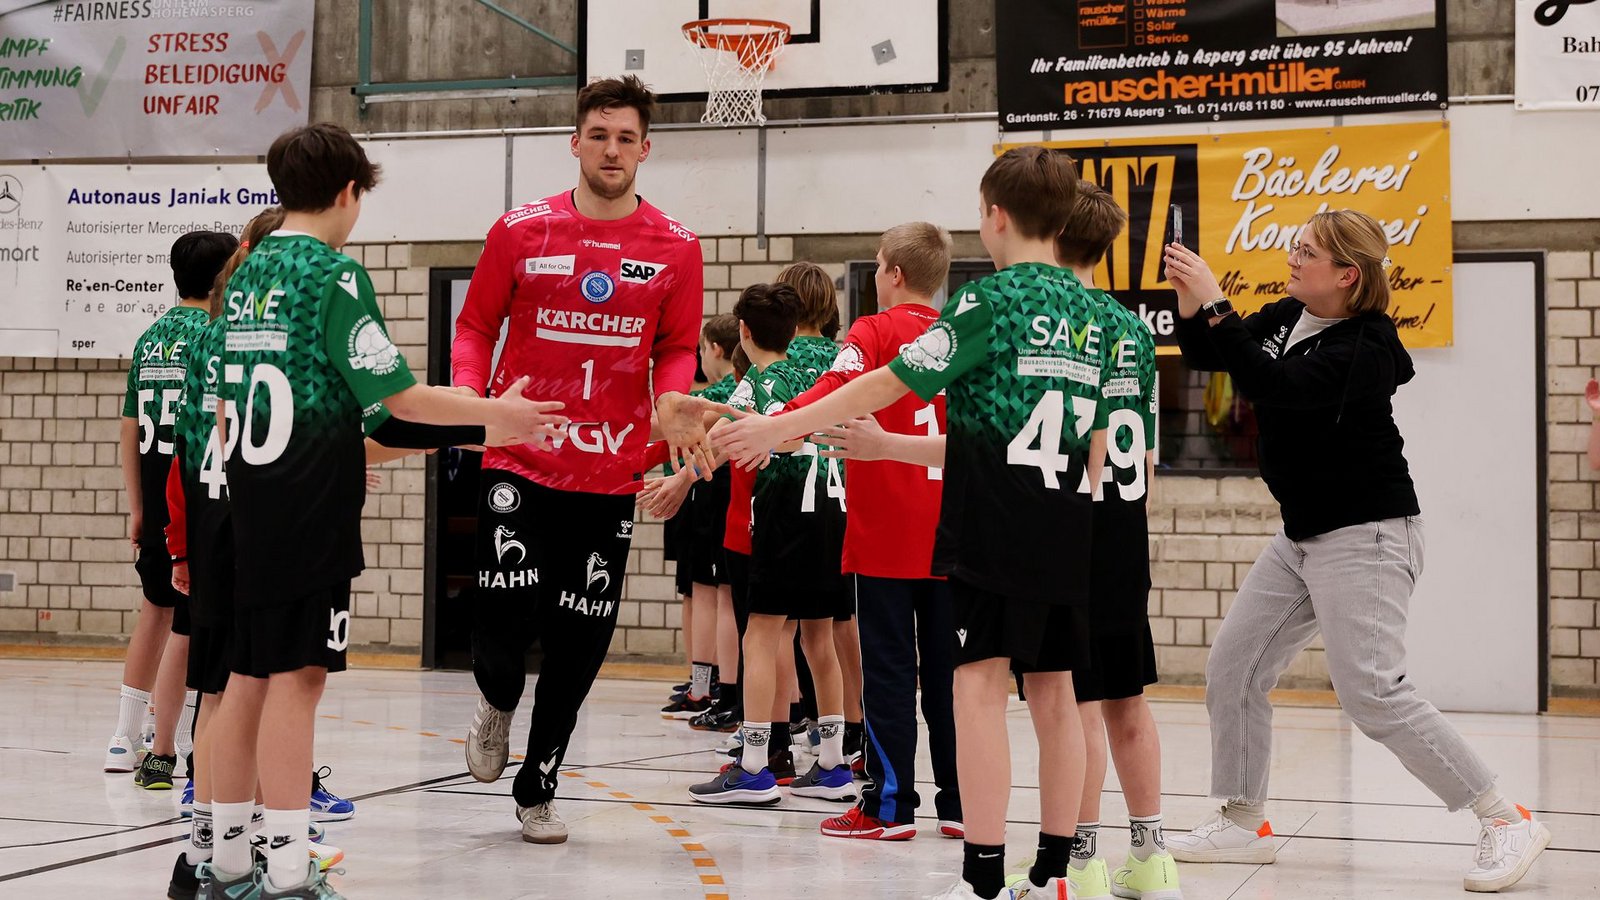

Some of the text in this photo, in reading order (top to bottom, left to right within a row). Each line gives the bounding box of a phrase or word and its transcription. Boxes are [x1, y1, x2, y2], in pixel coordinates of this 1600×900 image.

[53, 0, 151, 22] #FAIRNESS
[1080, 4, 1126, 15] rauscher
[1146, 8, 1186, 18] Wärme
[1146, 21, 1177, 31] Solar
[147, 32, 229, 53] STRESS
[1146, 33, 1189, 44] Service
[1030, 36, 1414, 74] Ihr Familienbetrieb in Asperg seit über 95 Jahren!
[144, 62, 288, 86] BELEIDIGUNG
[1064, 61, 1367, 105] rauscher+müller GMBH
[1576, 86, 1600, 103] 07
[143, 95, 220, 116] UNFAIR
[1006, 112, 1061, 124] Gartenstr.
[1063, 110, 1078, 121] 26
[1087, 107, 1121, 120] 71679
[1124, 106, 1165, 120] Asperg
[1174, 104, 1195, 116] Tel.
[1295, 91, 1438, 109] www.rauschermueller.de
[1232, 145, 1419, 201] Bäckerei
[66, 220, 244, 235] Autorisierter Mercedes-Benz
[669, 221, 696, 242] WGV
[591, 240, 621, 251] hummel
[66, 250, 143, 266] Autorisierter
[621, 262, 656, 281] SAP
[1219, 270, 1289, 297] Mir mac
[536, 307, 647, 334] KÄRCHER
[581, 358, 595, 401] 1
[478, 568, 539, 588] HAHN
[559, 590, 615, 617] HAHN
